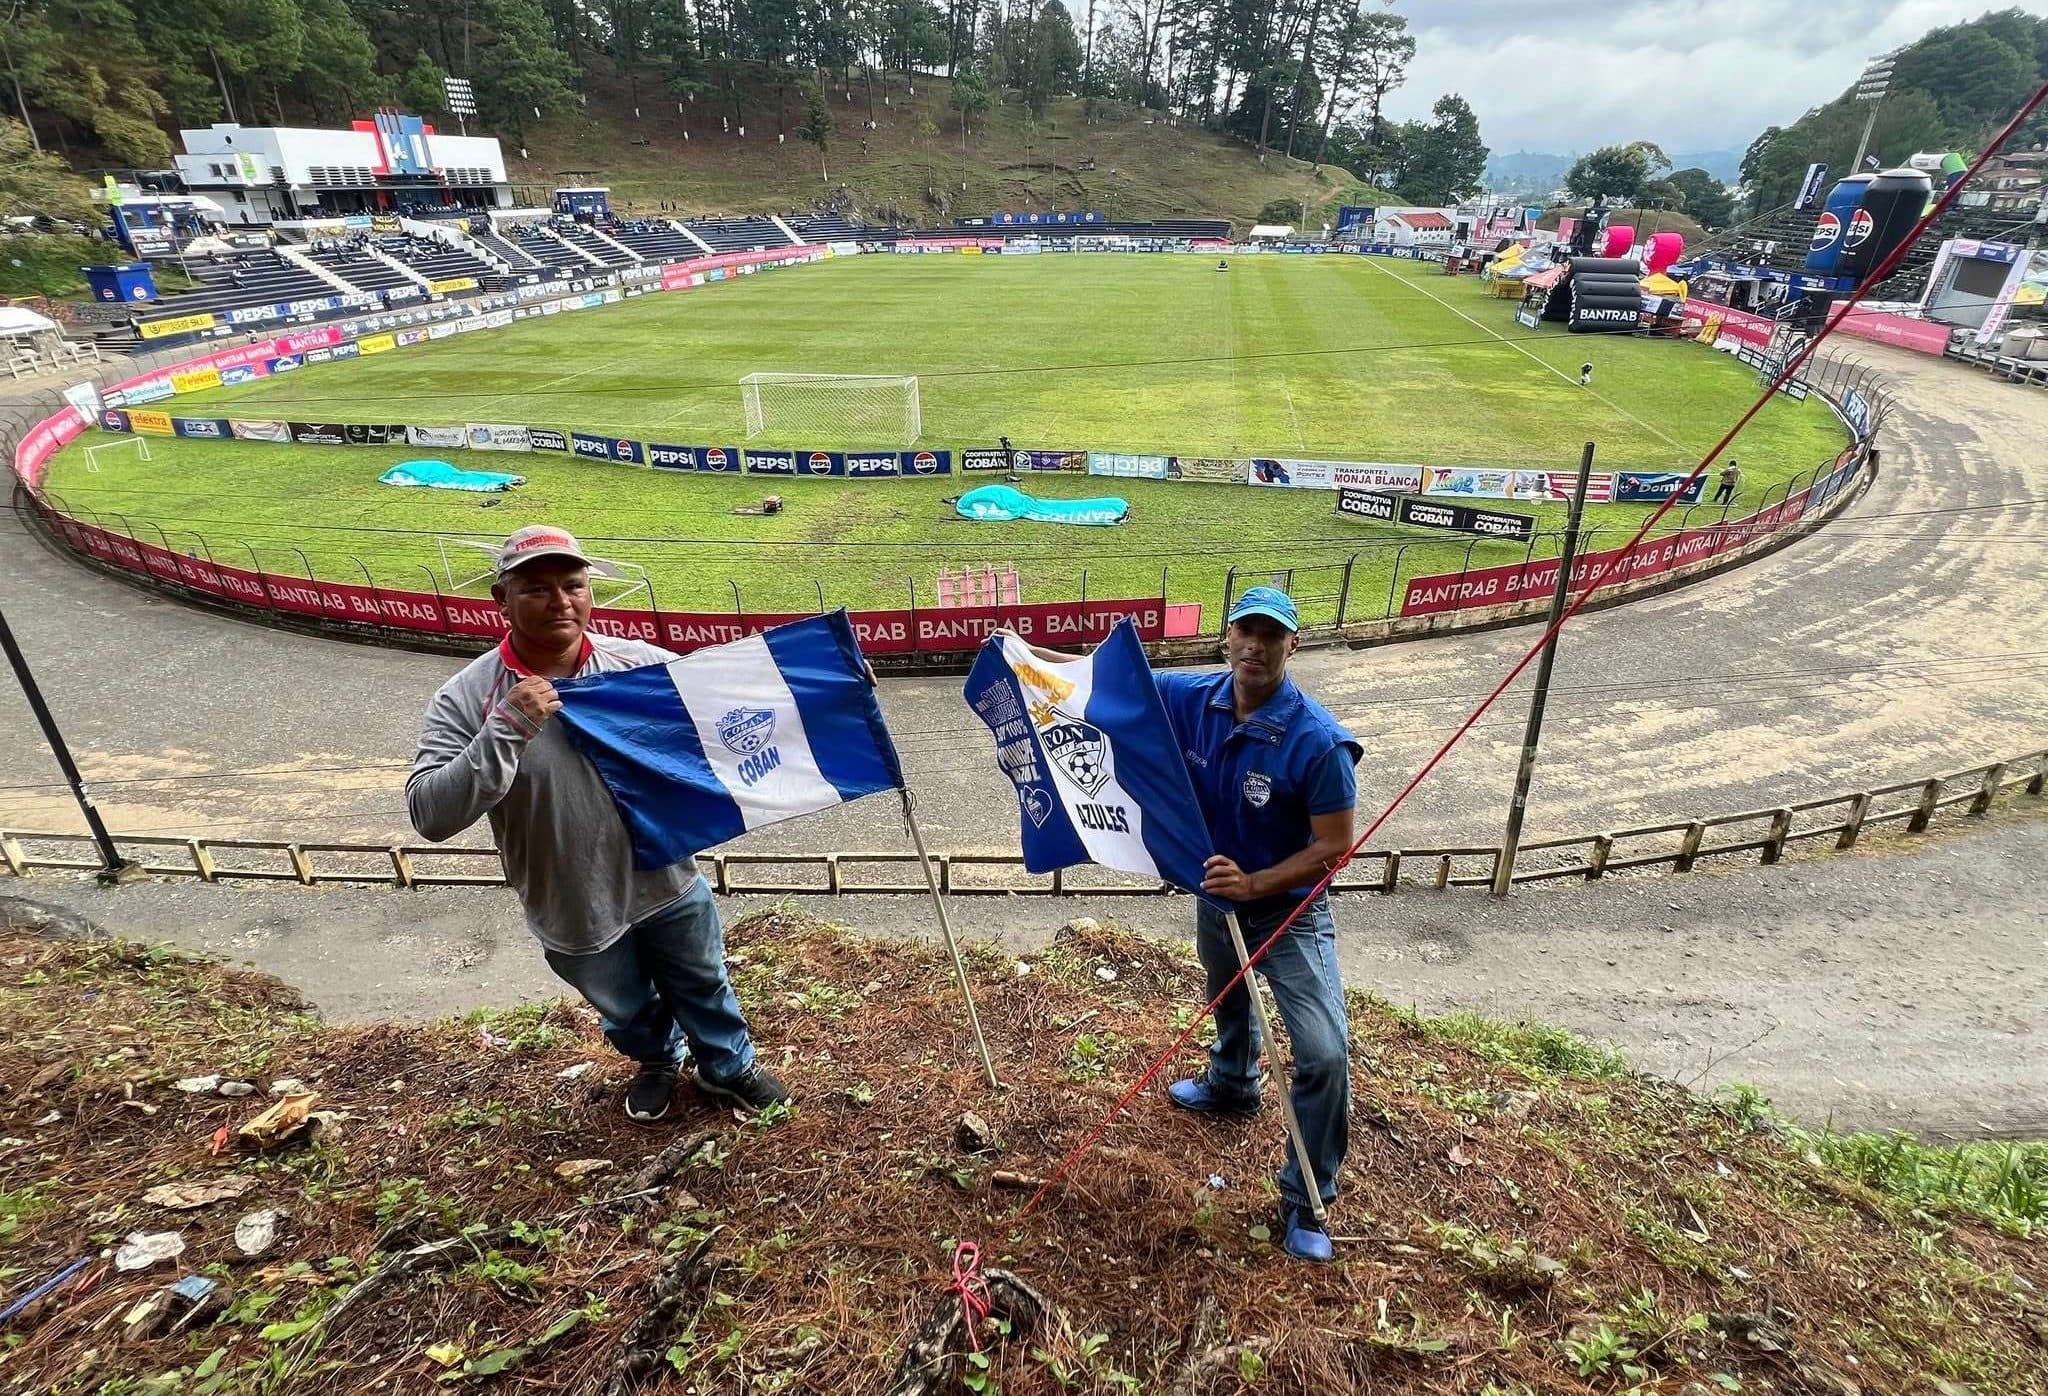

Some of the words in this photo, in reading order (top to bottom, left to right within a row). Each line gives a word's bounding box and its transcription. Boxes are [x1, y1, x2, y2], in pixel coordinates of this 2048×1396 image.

[234, 304, 275, 321] PEPSI
[290, 299, 326, 315] PEPSI
[342, 292, 377, 306] PEPSI
[389, 285, 418, 299] PEPSI
[1580, 308, 1637, 321] BANTRAB
[136, 412, 167, 426] elektra
[574, 438, 607, 454] PEPSI
[651, 450, 694, 465] PEPSI
[746, 456, 793, 470] PEPSI
[915, 460, 936, 468] PEPSI
[848, 459, 898, 471] PEPSI
[1335, 467, 1388, 476] TRANSPORTES
[1334, 474, 1371, 485] MONJA
[1375, 475, 1418, 488] BLANCA
[1343, 490, 1392, 506] COOPERATIVA
[1411, 504, 1454, 516] COOPERATIVA
[1476, 513, 1522, 526] COOPERATIVA
[1408, 578, 1498, 606] BANTRAB
[199, 567, 264, 598] BANTRAB
[268, 583, 345, 611] BANTRAB
[350, 595, 438, 622] BANTRAB
[448, 606, 512, 630] BANTR
[586, 618, 657, 640] NTRAB
[668, 623, 775, 643] BANTRA
[919, 616, 1033, 639] BANTRAB
[1046, 609, 1158, 633] BANTRAB
[737, 746, 781, 787] COBAN
[1075, 803, 1130, 834] AZULES
